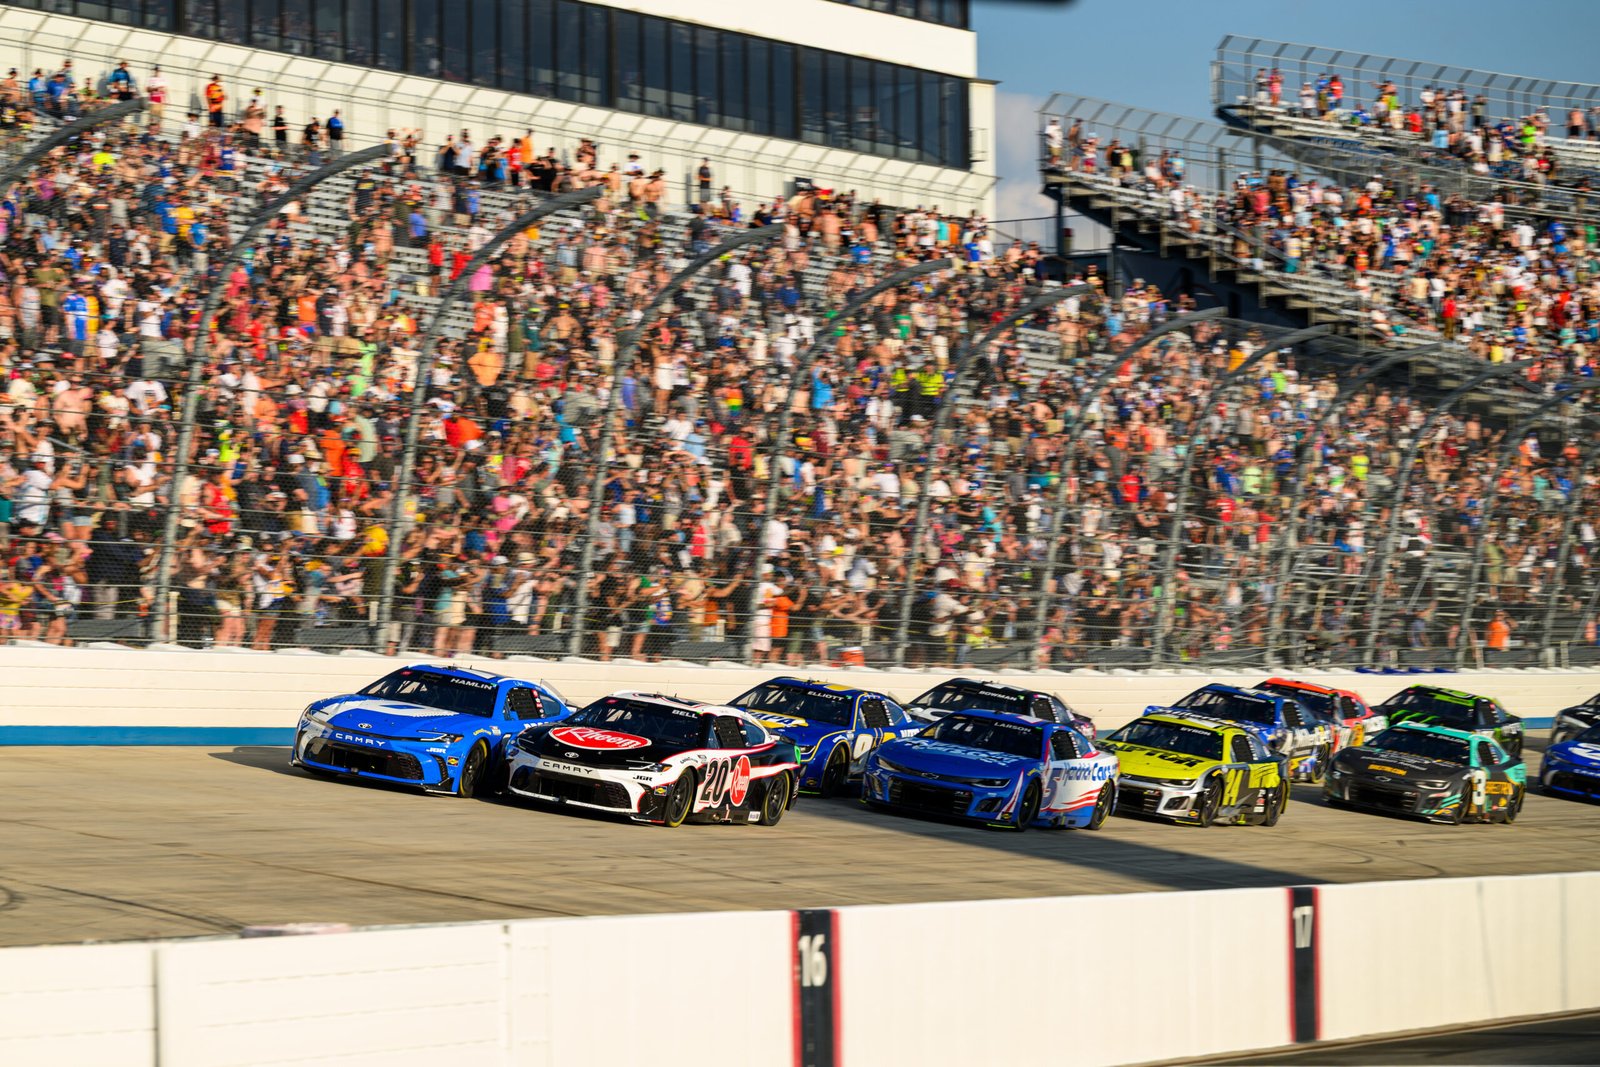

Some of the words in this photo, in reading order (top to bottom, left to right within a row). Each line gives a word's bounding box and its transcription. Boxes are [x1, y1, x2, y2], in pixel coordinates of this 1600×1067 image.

[451, 678, 492, 690] HAMLIN
[807, 690, 844, 701] ELLIOTT
[978, 690, 1017, 702] BOWMAN
[672, 709, 698, 719] BELL
[994, 721, 1032, 733] LARSON
[1180, 726, 1212, 737] BYRON
[335, 732, 386, 747] CAMRY
[556, 727, 642, 748] Rheem
[543, 761, 593, 775] CAMRY
[633, 774, 653, 782] JGR
[700, 758, 731, 805] 20
[1040, 767, 1064, 810] 5
[1292, 906, 1314, 949] 17
[798, 934, 827, 987] 16
